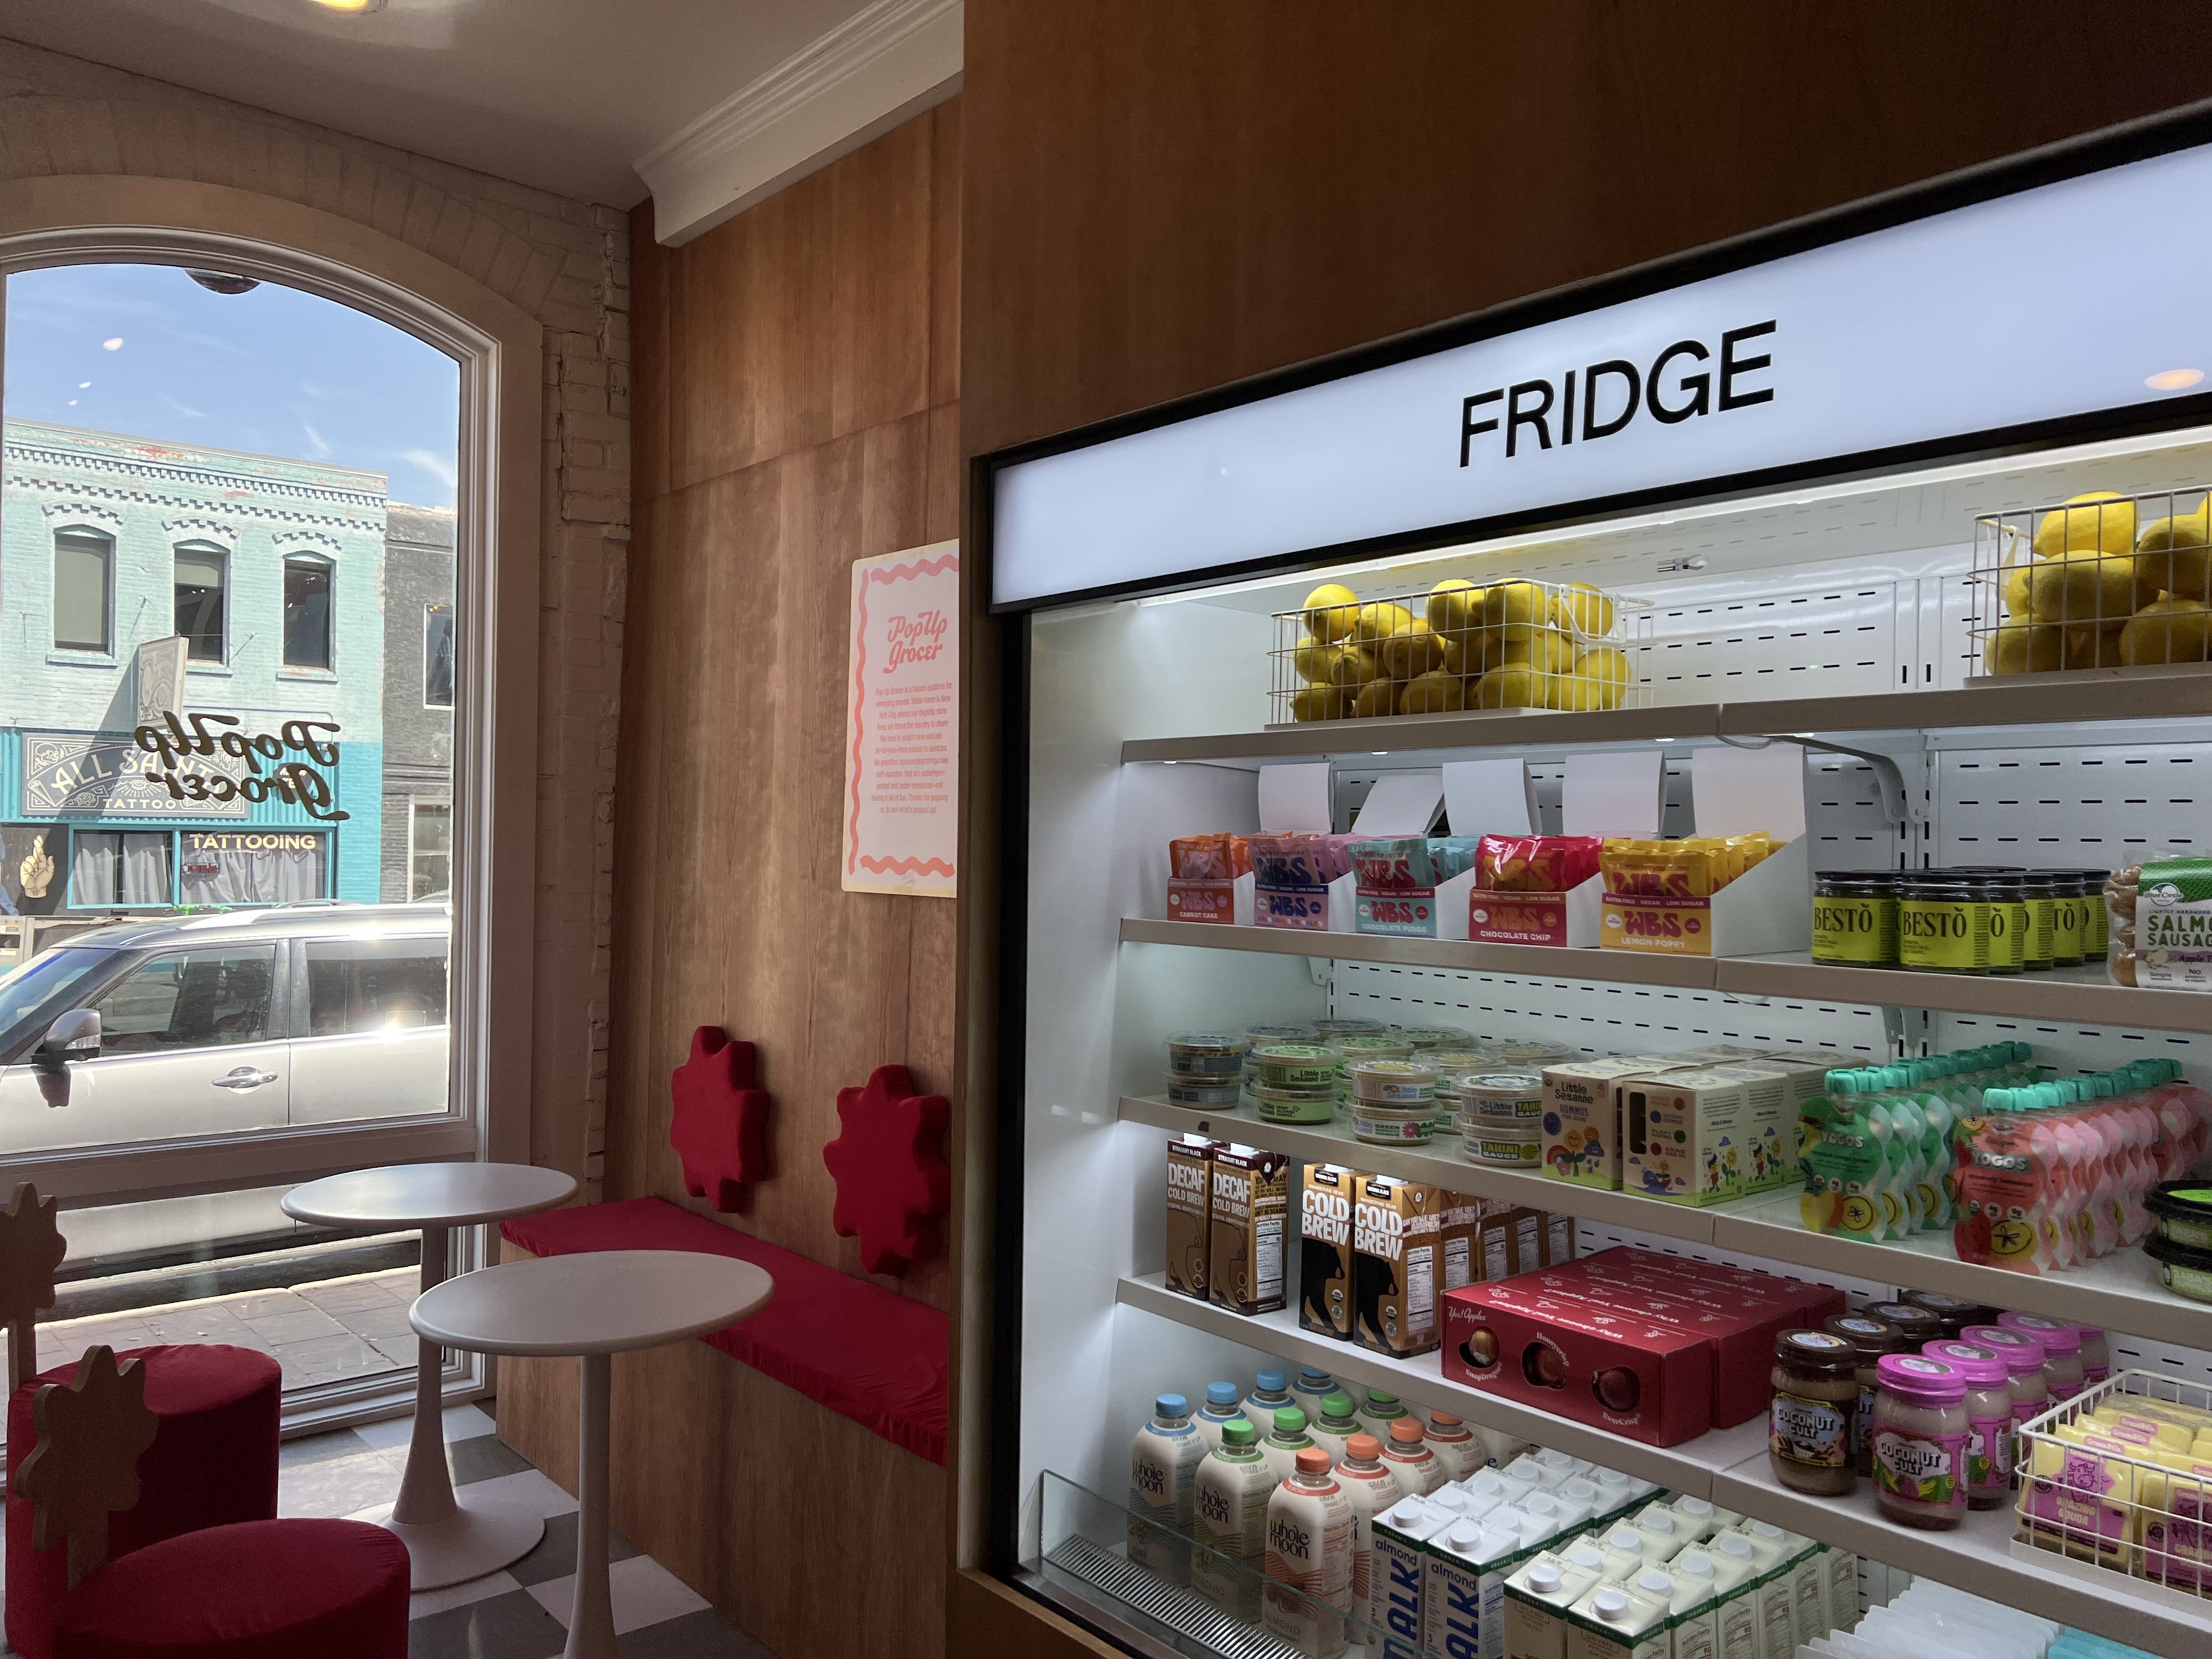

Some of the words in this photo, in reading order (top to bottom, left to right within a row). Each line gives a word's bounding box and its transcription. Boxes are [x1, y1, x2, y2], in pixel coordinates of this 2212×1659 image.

[1460, 319, 1776, 467] FRIDGE
[883, 640, 943, 674] Grocer
[884, 688, 889, 696] Up
[928, 683, 945, 692] platform
[918, 708, 935, 717] flagship
[50, 754, 112, 794] ALL
[103, 798, 177, 809] TATTOO
[913, 806, 929, 814] popped
[189, 833, 316, 849] TATTOOING
[183, 864, 218, 873] PEN
[1481, 930, 1528, 940] CHOCOLATE
[1621, 937, 1652, 946] LEMON
[1655, 940, 1685, 948] POPPY
[2148, 933, 2212, 947] SAUSAG
[2180, 955, 2204, 965] Apple
[1561, 1081, 1587, 1094] Little
[1555, 1088, 1594, 1104] Sesame
[1480, 1107, 1513, 1116] Sesame
[1489, 1102, 1513, 1110] Little
[1560, 1104, 1589, 1116] HUMMUS
[1483, 1143, 1519, 1153] TAHINI
[1822, 1132, 1864, 1149] YOGOS
[1172, 1145, 1189, 1154] STRAIGHT
[1482, 1151, 1519, 1159] SAUCE
[1218, 1154, 1235, 1164] STRAIGHT
[1235, 1159, 1247, 1167] BLACK
[1168, 1163, 1205, 1192] DECAF
[1214, 1172, 1251, 1203] DECAF
[1168, 1187, 1186, 1200] COLD
[1187, 1192, 1204, 1206] BREW
[1213, 1198, 1230, 1212] COLD
[1231, 1203, 1250, 1218] BREW
[1302, 1189, 1350, 1222] COLD
[1355, 1203, 1403, 1236] COLD
[1302, 1212, 1350, 1246] BREW
[1355, 1227, 1403, 1261] BREW
[1536, 1331, 1570, 1367] Honeycrisp
[1778, 1406, 1835, 1431] COCONUT
[1789, 1426, 1818, 1439] CULT
[1384, 1452, 1404, 1462] ALMOND
[1881, 1441, 1942, 1468] COCONUT
[1132, 1459, 1165, 1481] whole
[1894, 1459, 1923, 1476] CULT
[1132, 1470, 1163, 1494] moon
[1287, 1483, 1307, 1494] ALMOND
[1196, 1484, 1230, 1511] whole
[1323, 1500, 1339, 1508] SHAKE
[1195, 1502, 1228, 1523] moon
[1271, 1520, 1310, 1545] whole
[1384, 1528, 1408, 1543] ORGANIC
[1270, 1532, 1308, 1559] moon
[1375, 1539, 1417, 1566] almond
[1440, 1553, 1466, 1567] ORGANIC
[1491, 1556, 1512, 1568] ORGANIC
[1431, 1564, 1476, 1591] almond
[1739, 1607, 1751, 1616] Facts
[1446, 1582, 1479, 1659] ALK
[1585, 1622, 1615, 1638] ORGANIC
[1698, 1628, 1710, 1637] Facts
